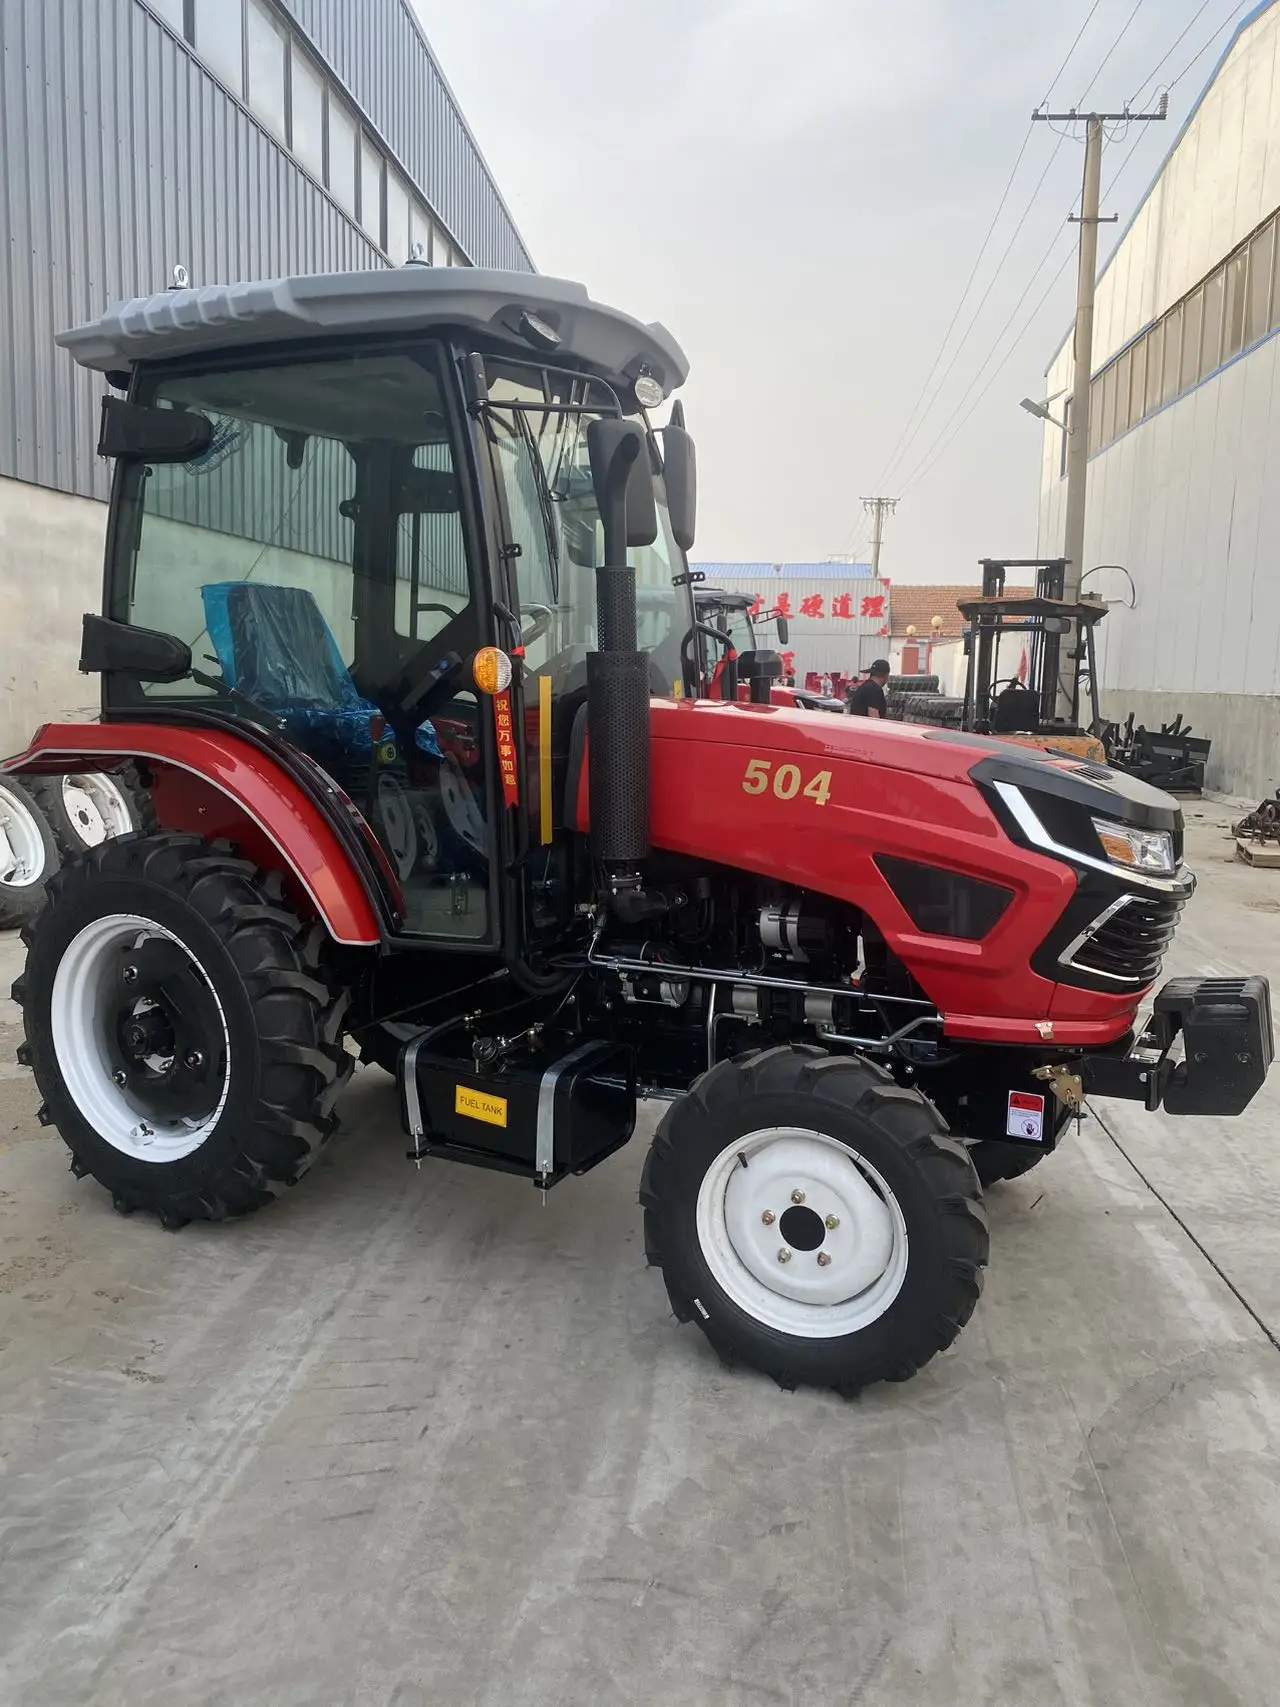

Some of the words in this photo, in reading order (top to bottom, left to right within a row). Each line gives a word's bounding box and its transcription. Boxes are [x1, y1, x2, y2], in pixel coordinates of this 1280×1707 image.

[496, 699, 517, 785] 祝您万事如意
[742, 758, 833, 806] 504
[459, 1095, 480, 1109] FUEL
[481, 1102, 503, 1116] TANK
